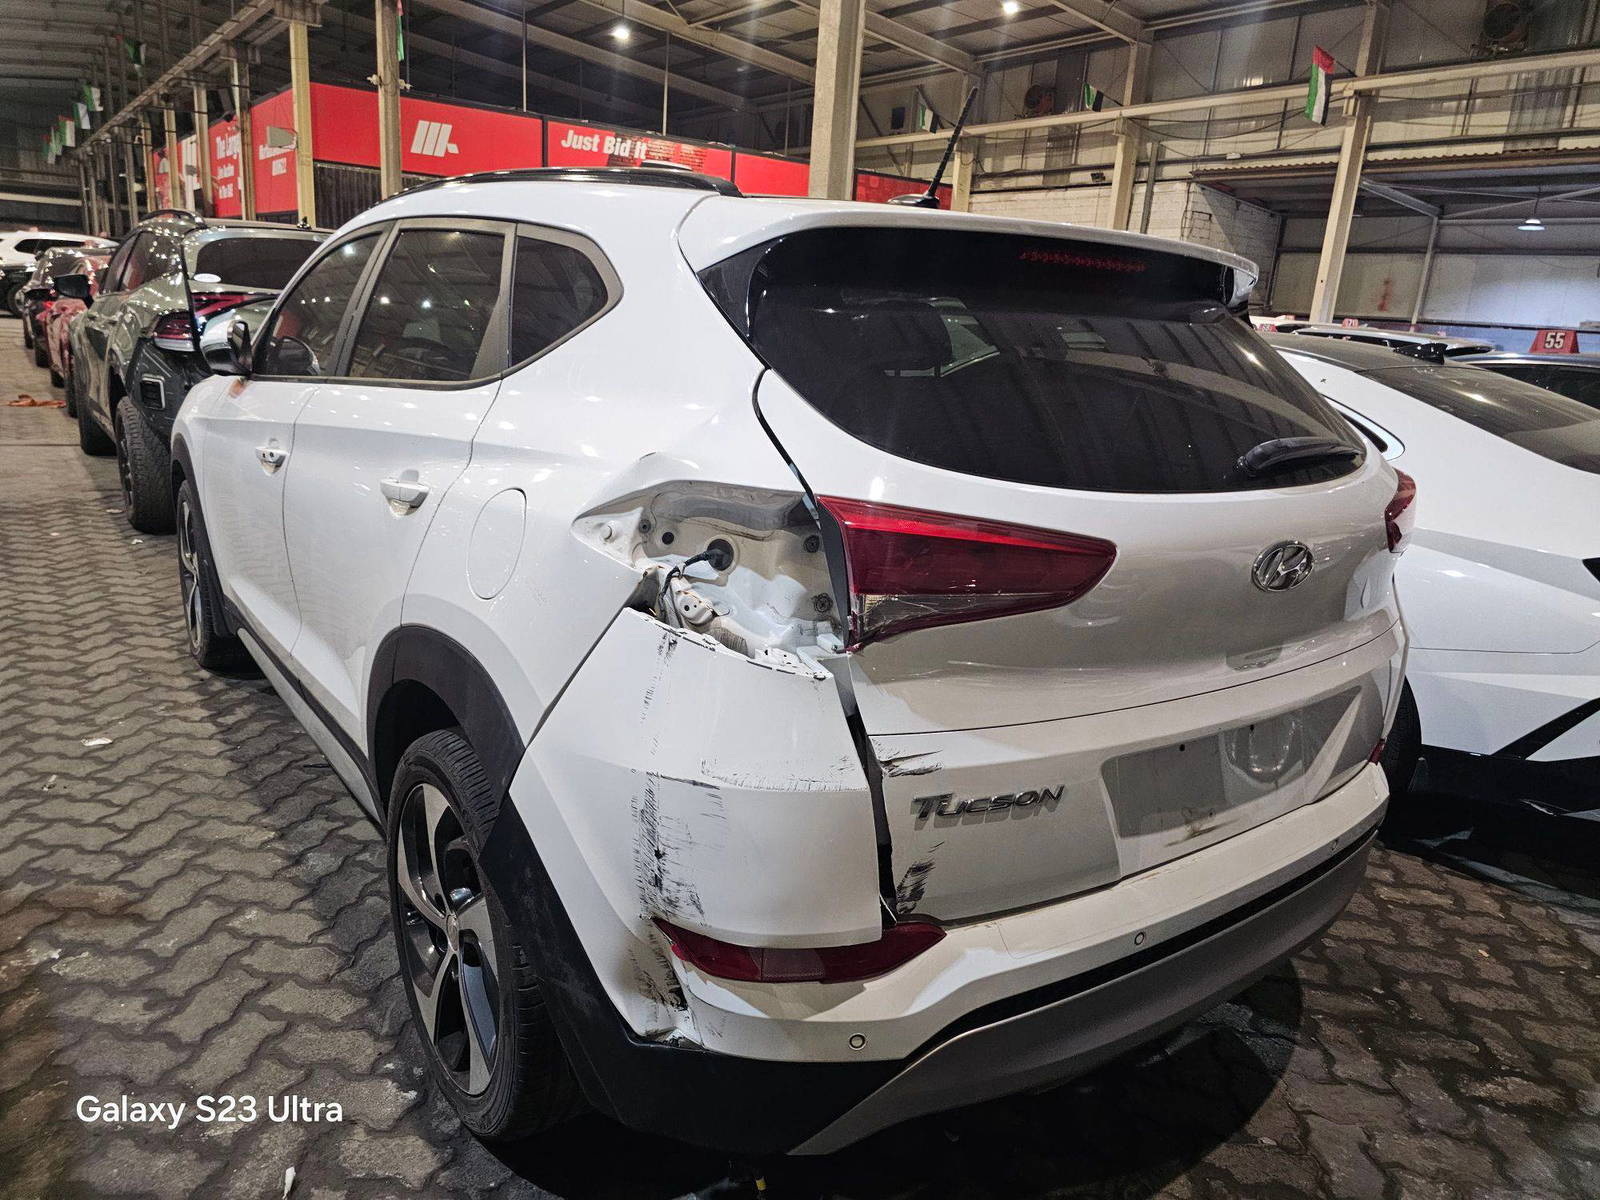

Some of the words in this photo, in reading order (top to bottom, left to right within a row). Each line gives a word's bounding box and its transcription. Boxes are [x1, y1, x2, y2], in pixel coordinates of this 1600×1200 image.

[561, 130, 600, 153] Just
[604, 135, 631, 158] Bid
[1544, 332, 1566, 349] 55
[913, 784, 1066, 820] TUCSON
